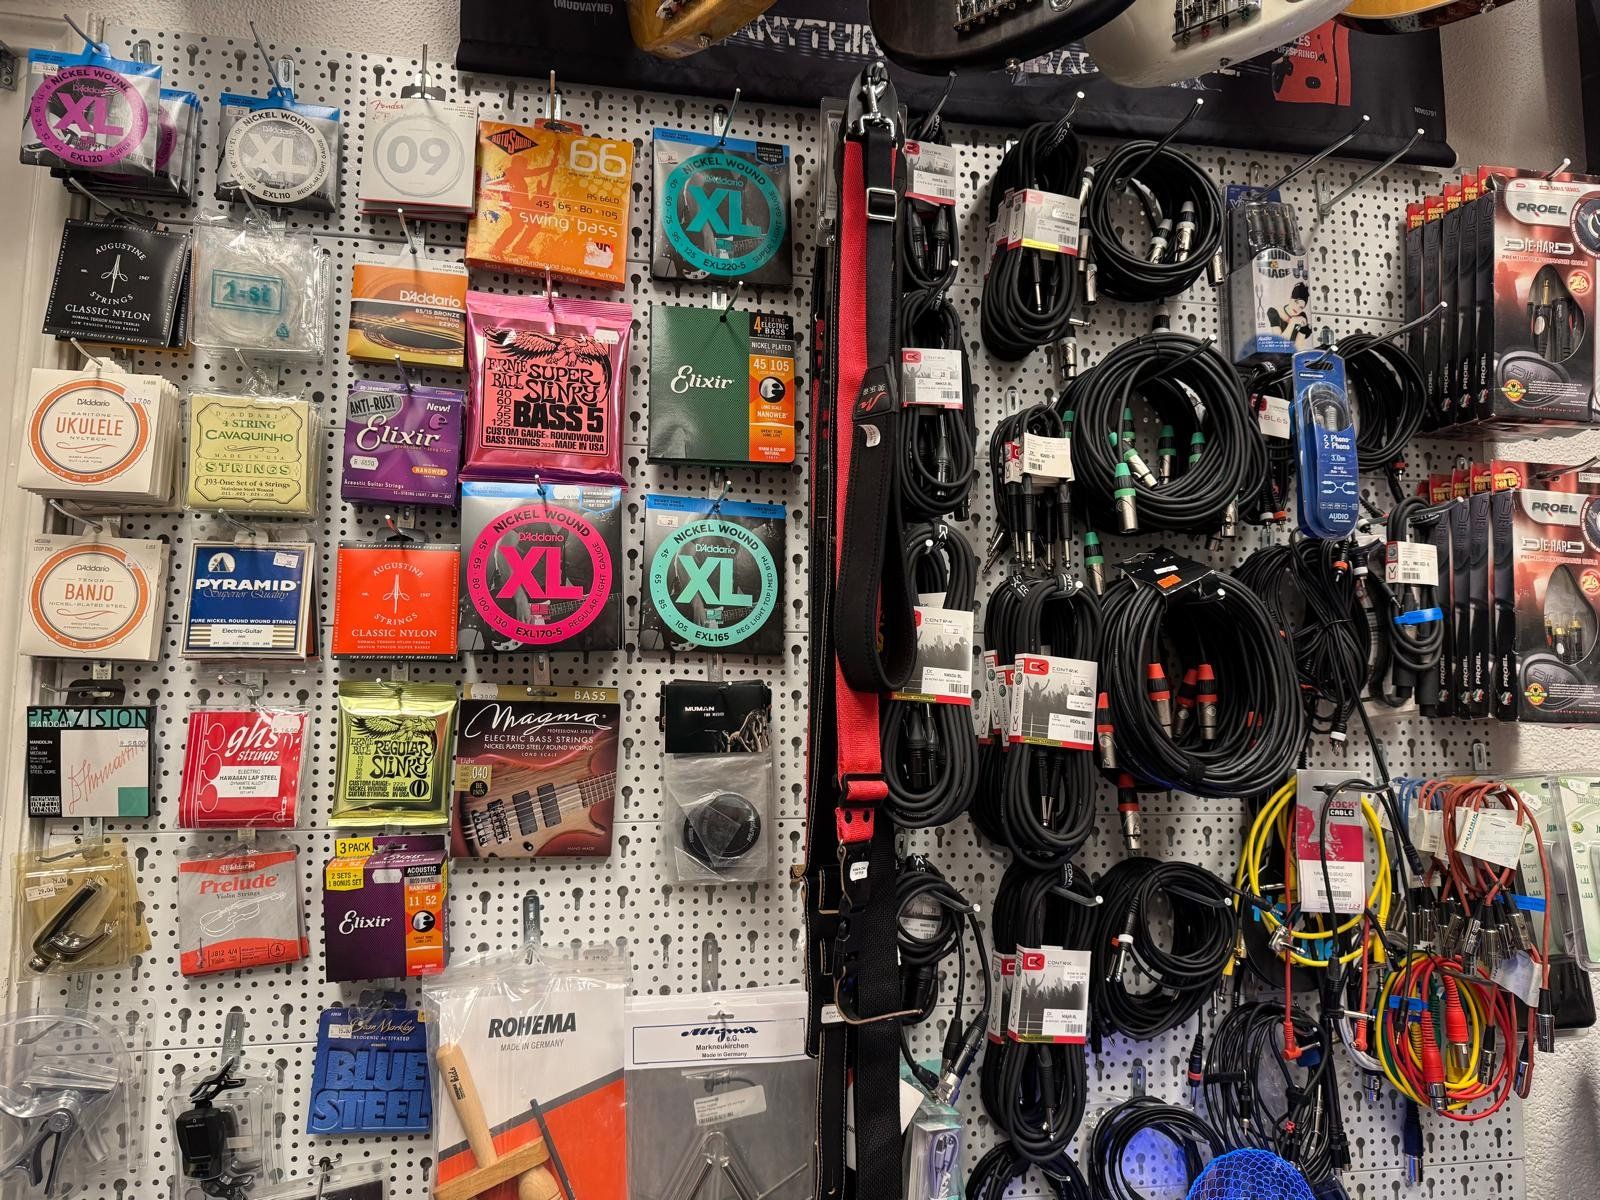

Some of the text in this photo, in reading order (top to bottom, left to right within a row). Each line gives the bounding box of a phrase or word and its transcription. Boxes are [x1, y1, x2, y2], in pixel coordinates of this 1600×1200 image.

[553, 0, 614, 14] (MUDVAYNE)
[370, 100, 404, 110] Fender
[53, 92, 124, 136] XL
[243, 111, 315, 135] NICKEL WOUND
[70, 151, 103, 163] EXL120
[248, 133, 309, 175] XL
[387, 135, 450, 176] 09
[569, 139, 627, 177] 66
[682, 156, 766, 186] NICKEL WOUND
[262, 189, 291, 199] EXL110
[685, 185, 762, 237] XL
[1516, 202, 1567, 216] PROEL
[519, 211, 618, 238] swing bass
[95, 242, 147, 261] AUGUSTINE
[1503, 237, 1575, 255] DIE-HARD
[703, 258, 746, 271] EXL220-5
[89, 290, 134, 305] STRINGS
[399, 290, 461, 308] D'Addario
[64, 303, 151, 322] CLASSIC NYLON
[754, 316, 761, 334] 4
[764, 327, 786, 336] BASS
[487, 356, 528, 375] ERNIE
[753, 358, 790, 372] 45 105
[491, 372, 524, 390] BALL
[527, 363, 600, 385] SUPER
[670, 365, 733, 394] Elixir
[523, 379, 600, 408] SLINKY
[76, 398, 110, 407] D'Addario
[350, 394, 396, 414] ANTI-RUST
[426, 402, 451, 413] New!
[232, 420, 276, 430] STRING
[513, 400, 604, 433] BASS 5
[55, 416, 124, 437] UKULELE
[356, 413, 441, 451] Elixir
[486, 426, 604, 443] CUSTOM ROUNDWOUND
[205, 429, 293, 443] CAVAQUINHO
[486, 435, 577, 449] BASS STRINGS MADE
[1330, 454, 1346, 462] 3.0m
[205, 461, 290, 475] STRINGS
[1532, 501, 1577, 516] PROEL
[493, 509, 591, 537] NICKEL WOUND
[673, 523, 759, 551] NICKEL WOUND
[1521, 537, 1585, 553] DIE-HARD
[76, 564, 110, 573] D'Addario
[372, 562, 425, 578] AUGUSTINE
[496, 547, 584, 599] XL
[195, 578, 297, 591] PYRAMID
[675, 555, 753, 607] XL
[64, 583, 114, 602] BANJO
[203, 589, 289, 600] Superior Quality
[373, 611, 419, 626] STRINGS
[515, 598, 599, 639] EXL170-5 REGULAR
[351, 629, 438, 638] CLASSIC NYLON
[694, 629, 730, 642] EXL165
[574, 690, 607, 701] BASS
[464, 703, 613, 738] Magma
[484, 734, 593, 744] ELECTRIC BASS STRINGS
[237, 748, 280, 765] strings
[374, 740, 432, 757] REGULAR
[369, 754, 431, 779] SLINKY
[340, 842, 370, 854] 3 PACK
[407, 866, 437, 874] ACOUSTIC
[199, 873, 278, 895] Prelude
[339, 910, 391, 934] Elixir
[488, 1012, 577, 1039] ROHEMA
[531, 1038, 564, 1050] GERMANY
[696, 1042, 749, 1051] Markneukirchen
[723, 1051, 747, 1059] Germany
[325, 1050, 428, 1091] BLUE
[311, 1089, 430, 1130] STEEL
